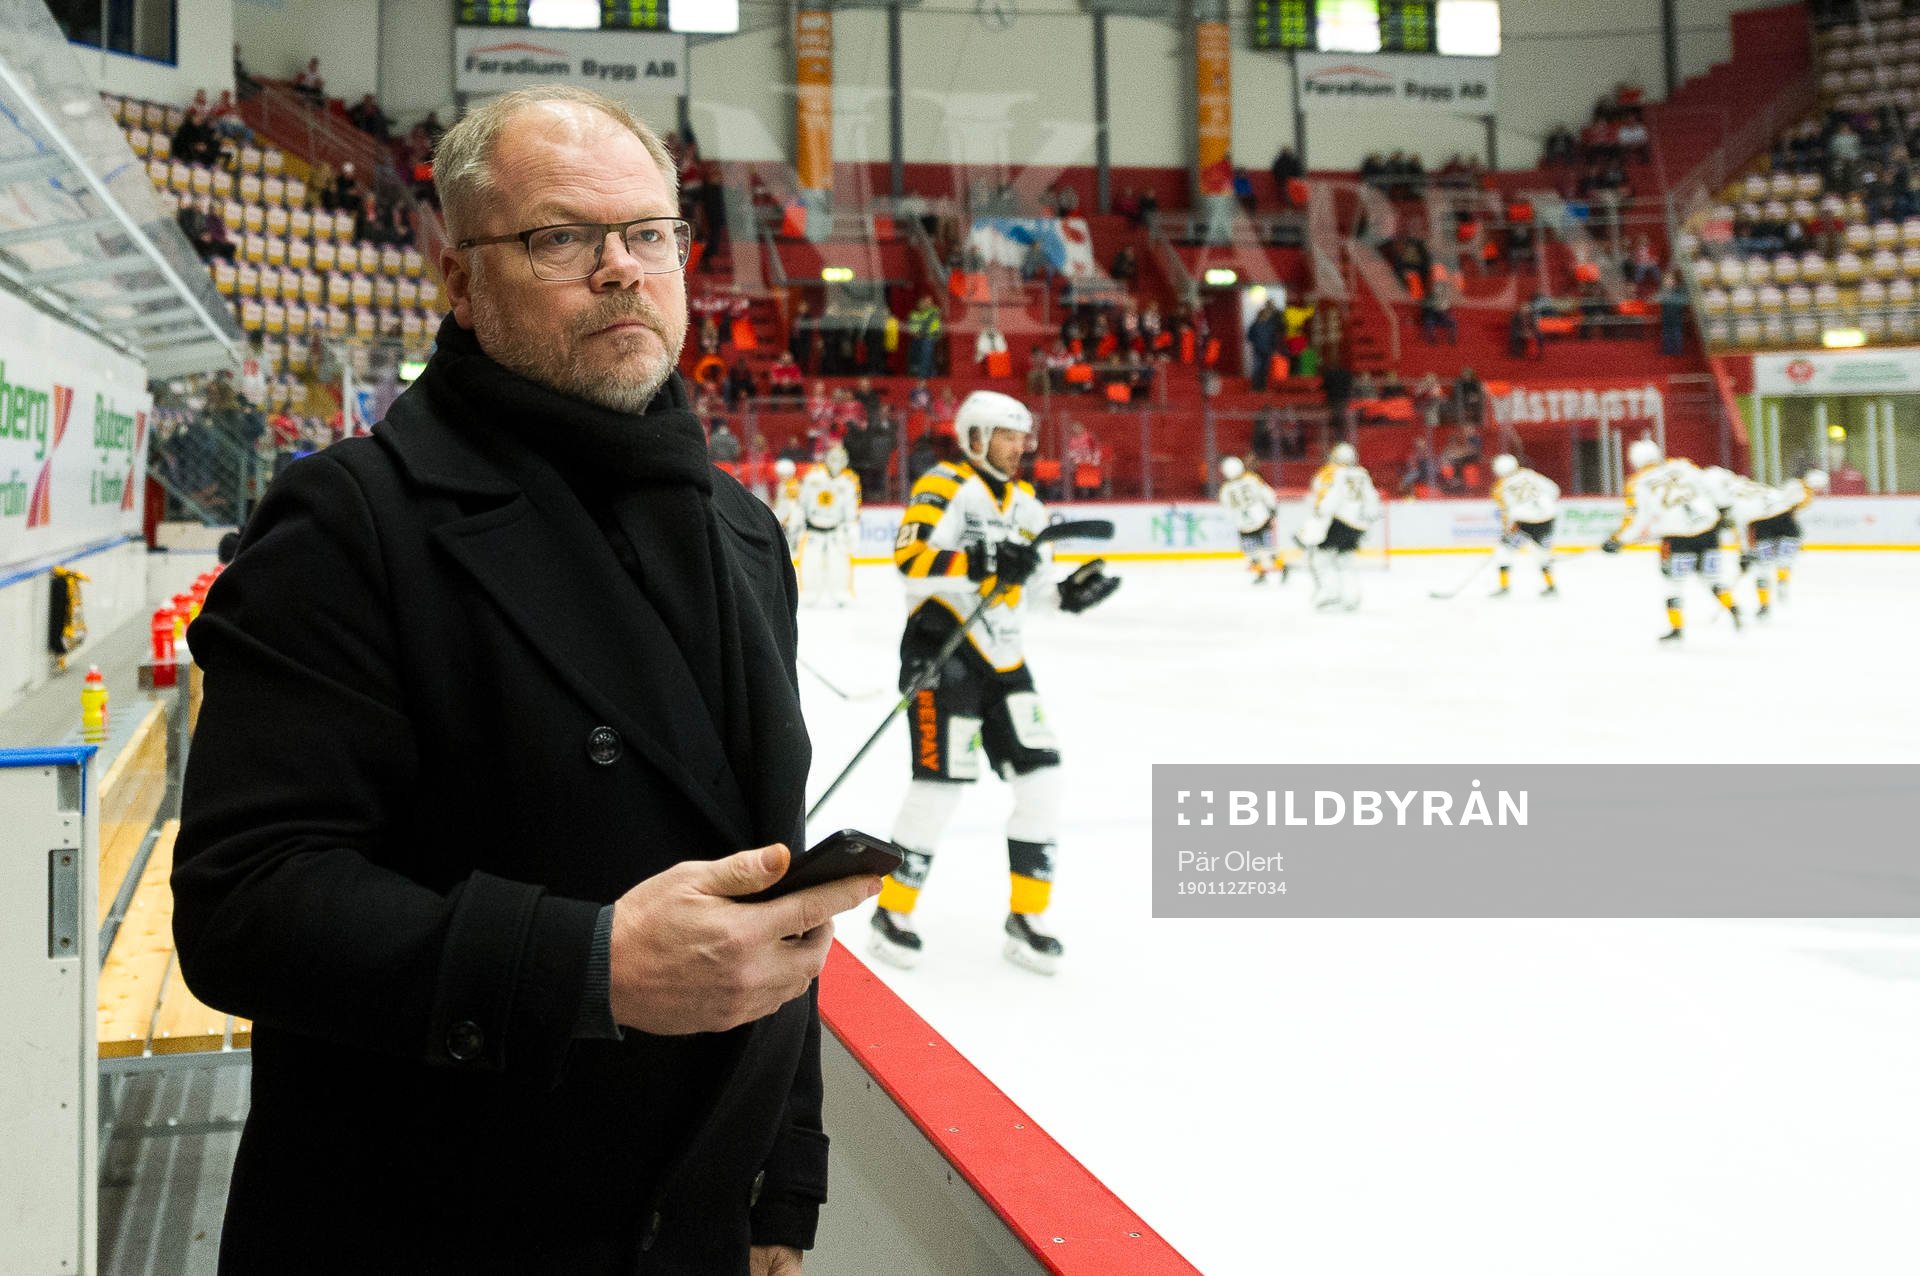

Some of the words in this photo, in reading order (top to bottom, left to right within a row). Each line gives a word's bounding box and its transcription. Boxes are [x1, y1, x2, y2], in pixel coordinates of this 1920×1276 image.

[581, 58, 638, 82] Bygg
[643, 60, 677, 78] AB
[1404, 80, 1454, 103] Bygg
[1459, 82, 1487, 98] AB
